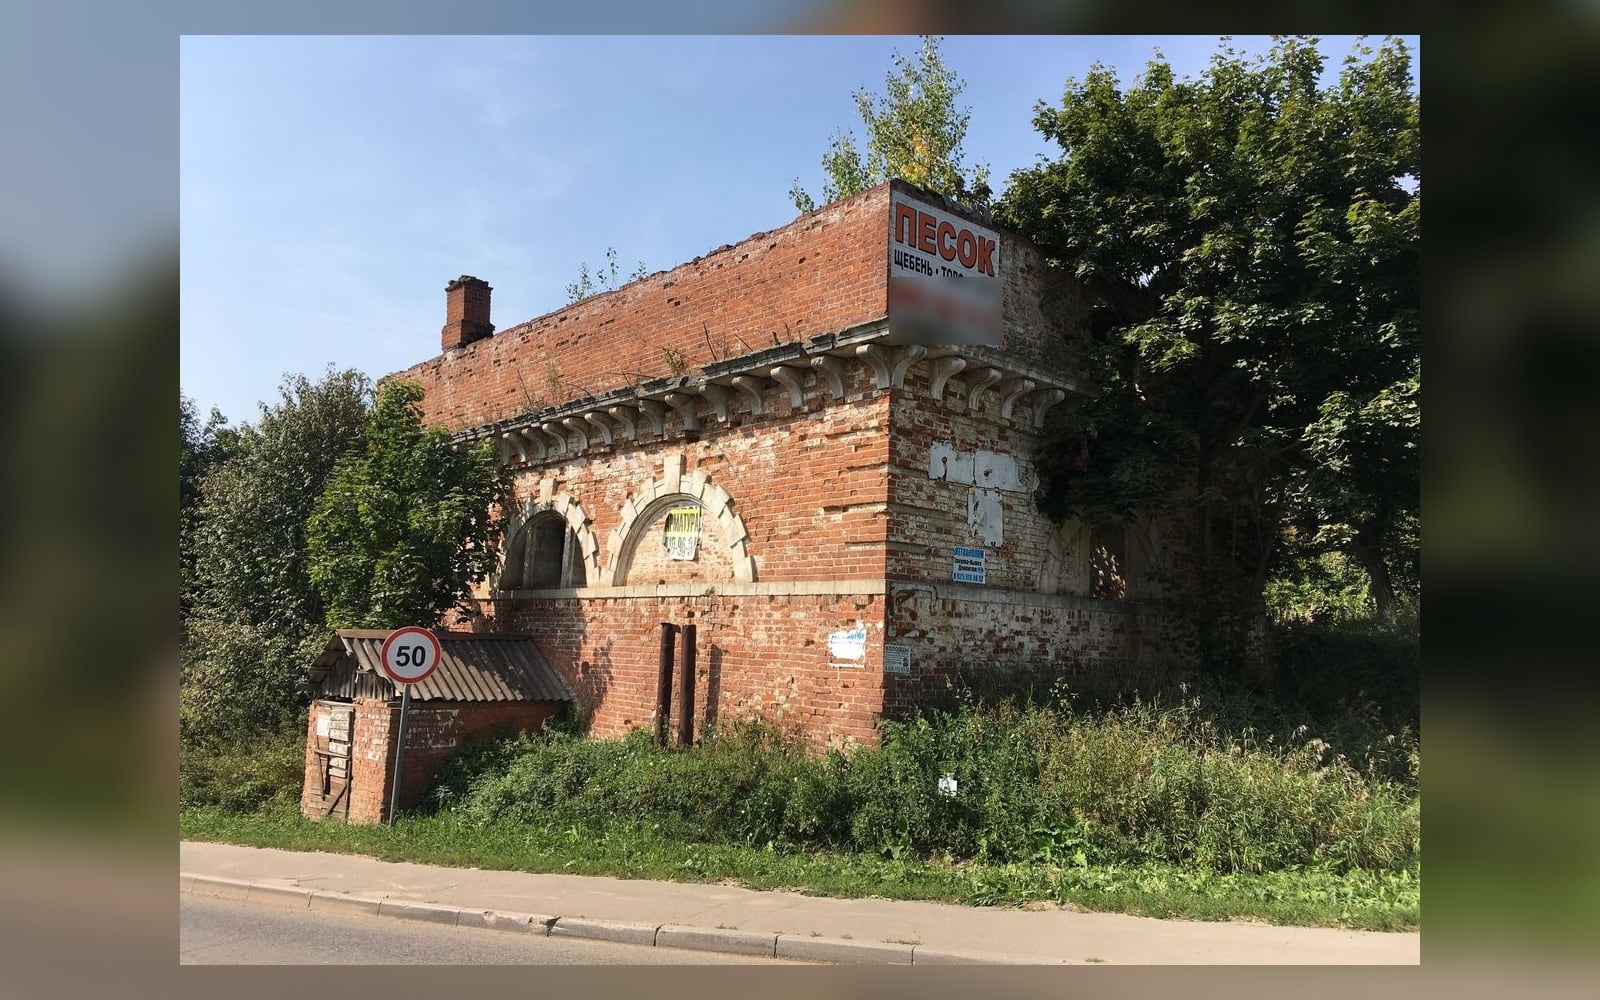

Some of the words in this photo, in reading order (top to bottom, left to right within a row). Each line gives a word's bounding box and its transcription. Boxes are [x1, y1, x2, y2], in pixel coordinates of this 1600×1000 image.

[895, 202, 995, 277] ПЕСОК
[894, 249, 932, 276] ЩЕБЕНЬ
[395, 645, 426, 667] 50
